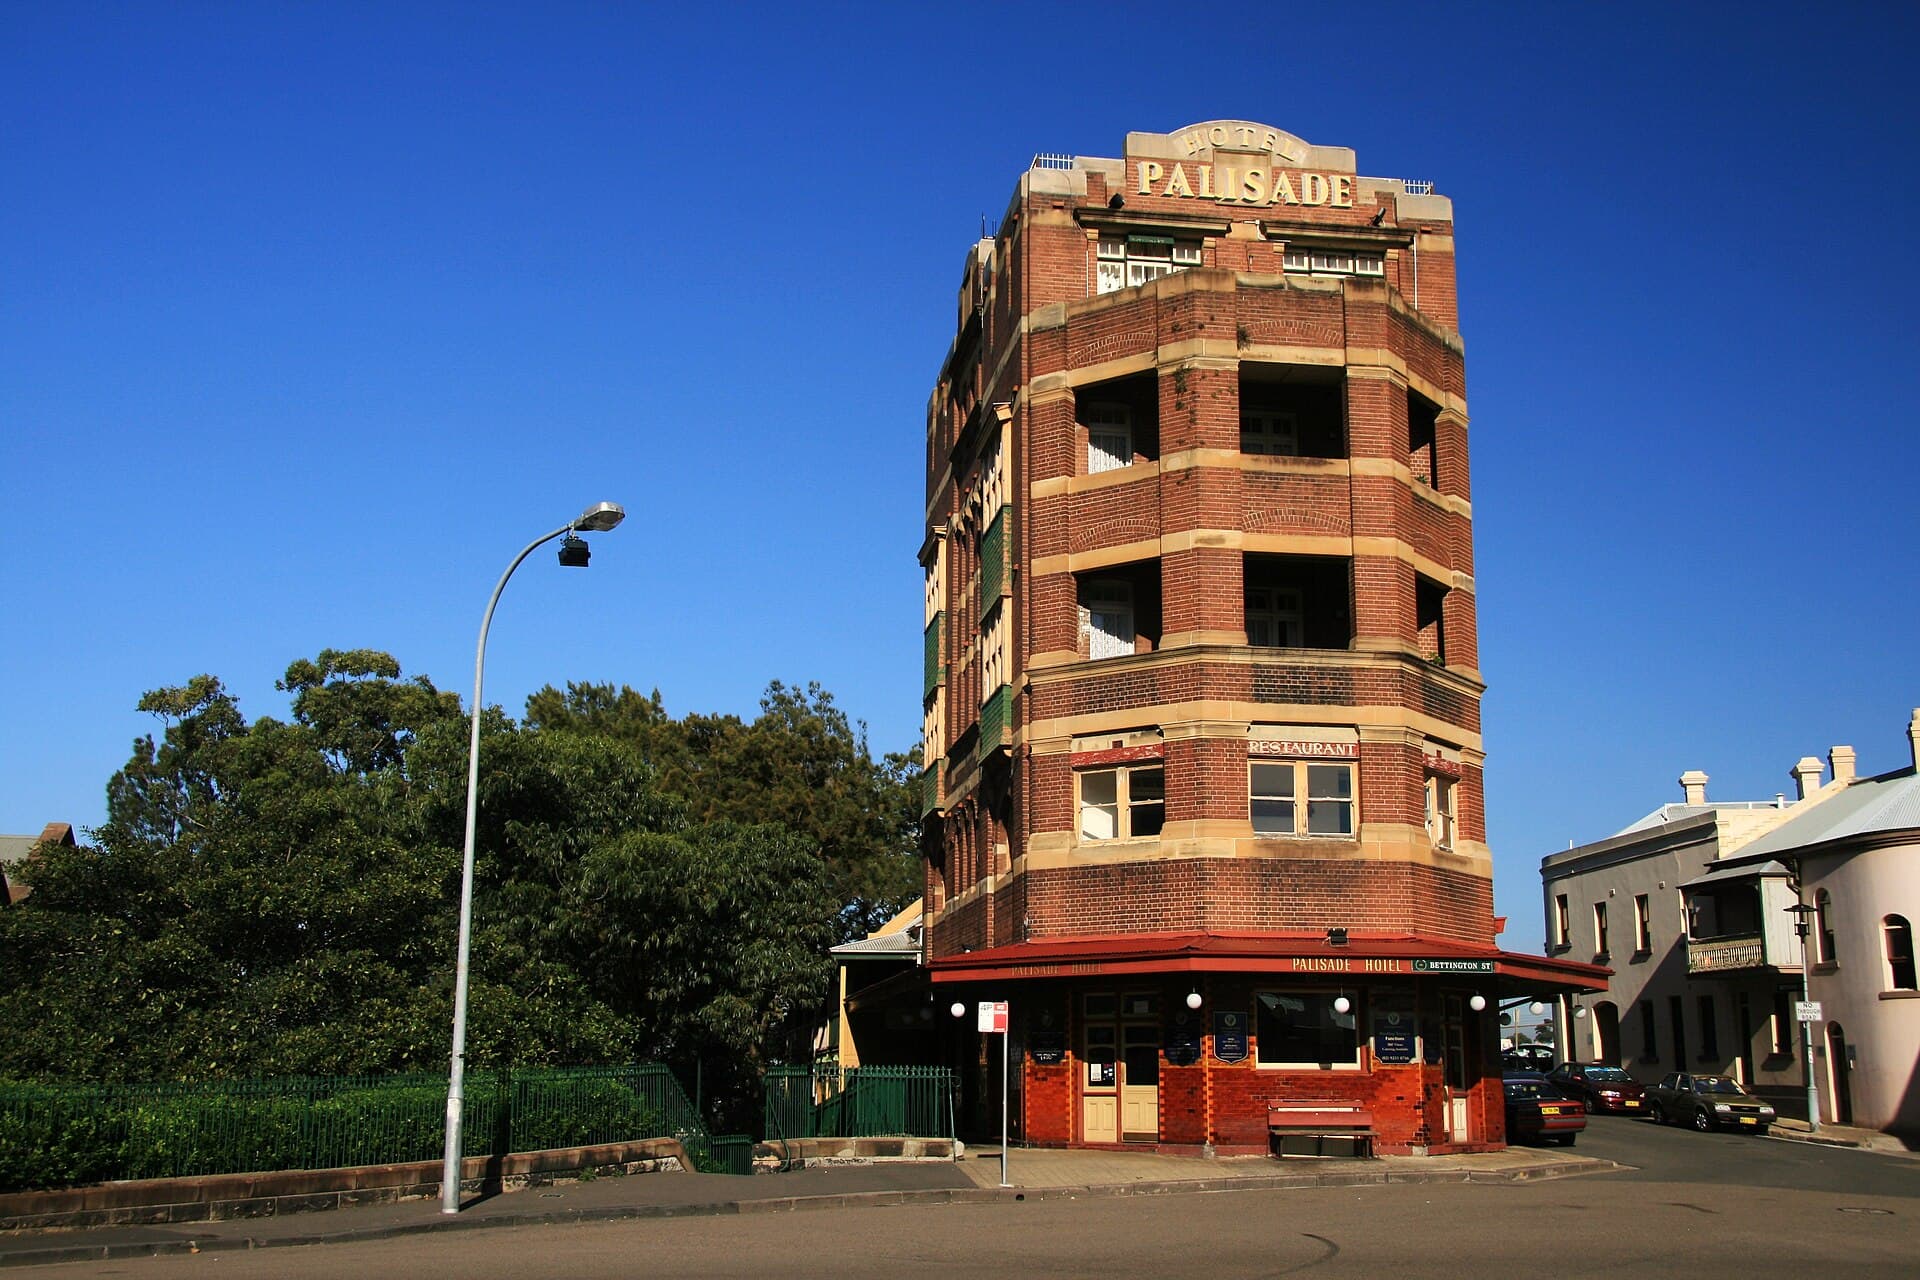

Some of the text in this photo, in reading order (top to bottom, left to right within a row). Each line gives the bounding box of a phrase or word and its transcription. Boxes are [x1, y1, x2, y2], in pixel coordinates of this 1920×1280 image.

[1181, 126, 1301, 162] HOTEL
[1137, 161, 1353, 207] PALISADE
[1248, 741, 1356, 756] RESTAURANT
[1011, 960, 1104, 977] PALISADE HOTEL
[1292, 958, 1403, 972] PALISADE HOTEL
[1429, 961, 1491, 970] BETTINGTON ST
